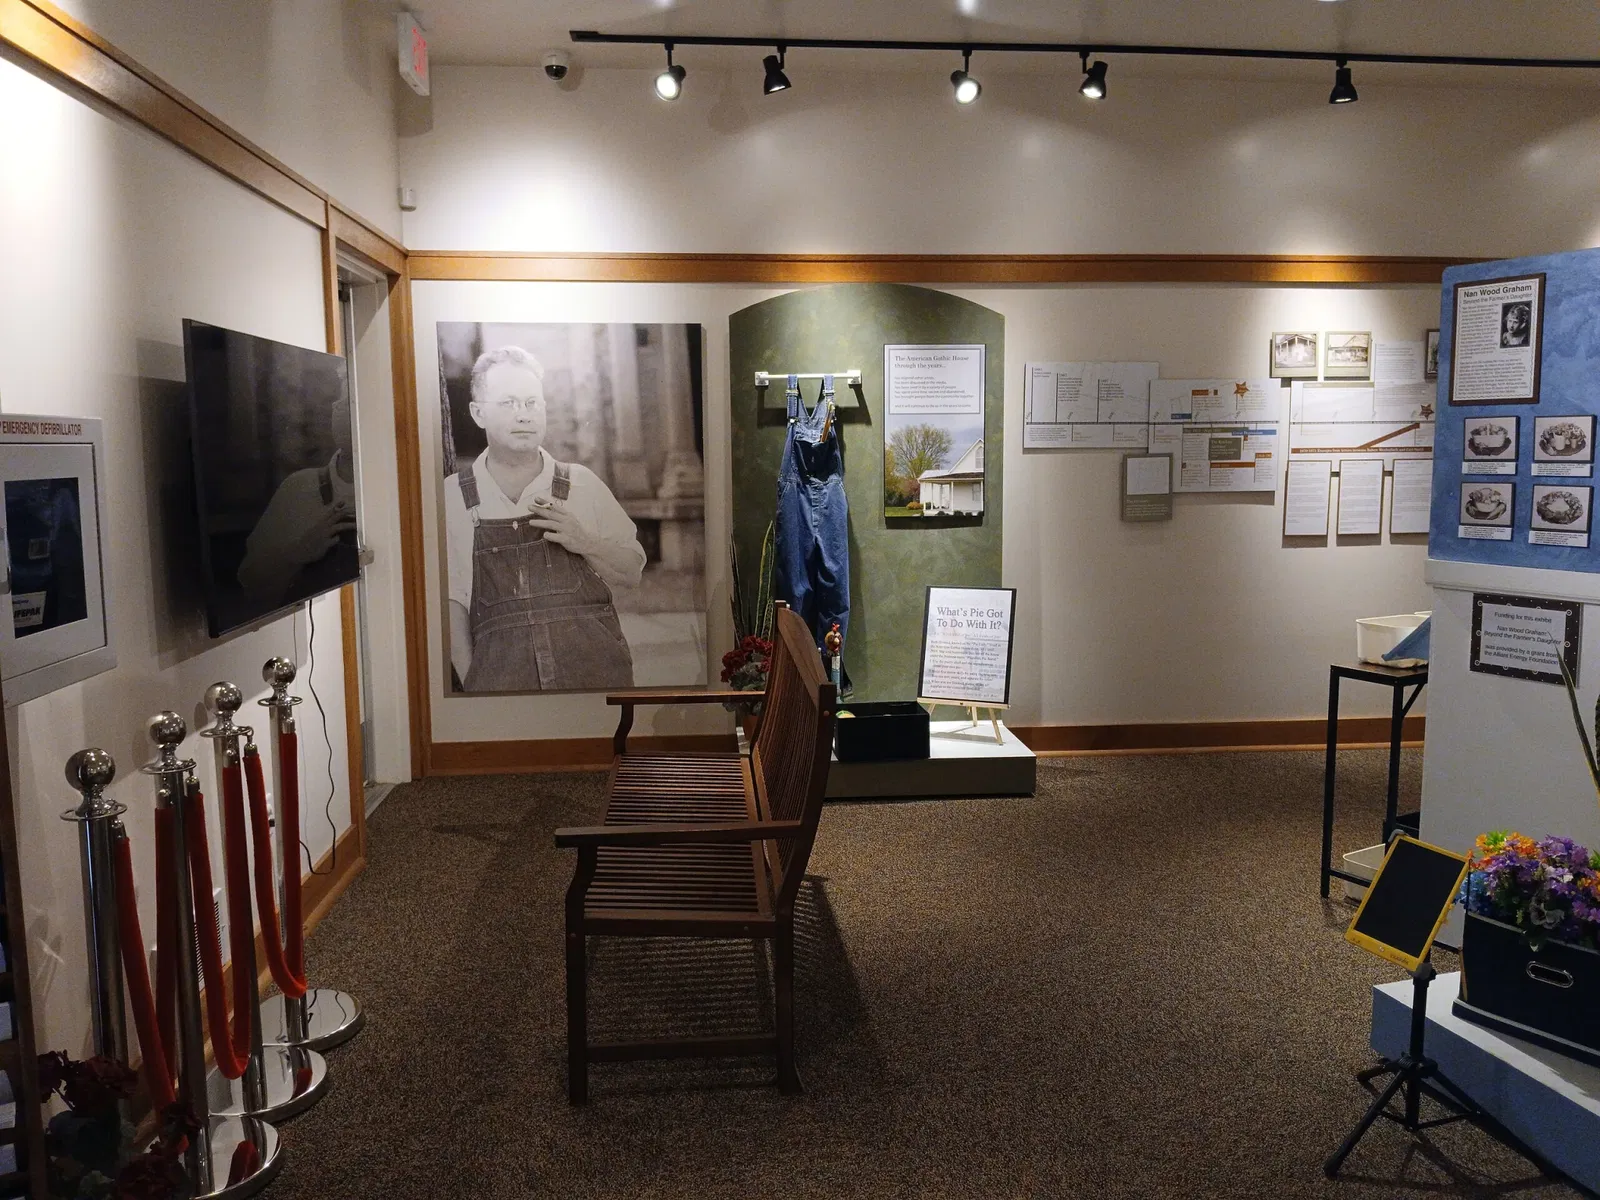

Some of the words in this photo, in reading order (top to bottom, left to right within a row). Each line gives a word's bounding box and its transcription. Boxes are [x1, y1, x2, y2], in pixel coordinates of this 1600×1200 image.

[1464, 290, 1478, 298] Nan
[1480, 288, 1500, 296] Wood
[1502, 284, 1532, 294] Graham
[2, 421, 39, 434] EMERGENCY
[40, 422, 82, 436] DEFIBRILLATOR
[936, 606, 968, 617] What's
[970, 608, 984, 618] Pie
[986, 608, 1004, 618] Got
[1494, 612, 1515, 620] Funding
[936, 618, 948, 628] To
[950, 618, 964, 628] Do
[966, 620, 987, 629] With
[988, 620, 1002, 630] It?
[1513, 634, 1536, 642] Farmer's
[1536, 636, 1562, 645] Daughter
[1510, 653, 1528, 662] Energy
[1531, 650, 1545, 658] grant
